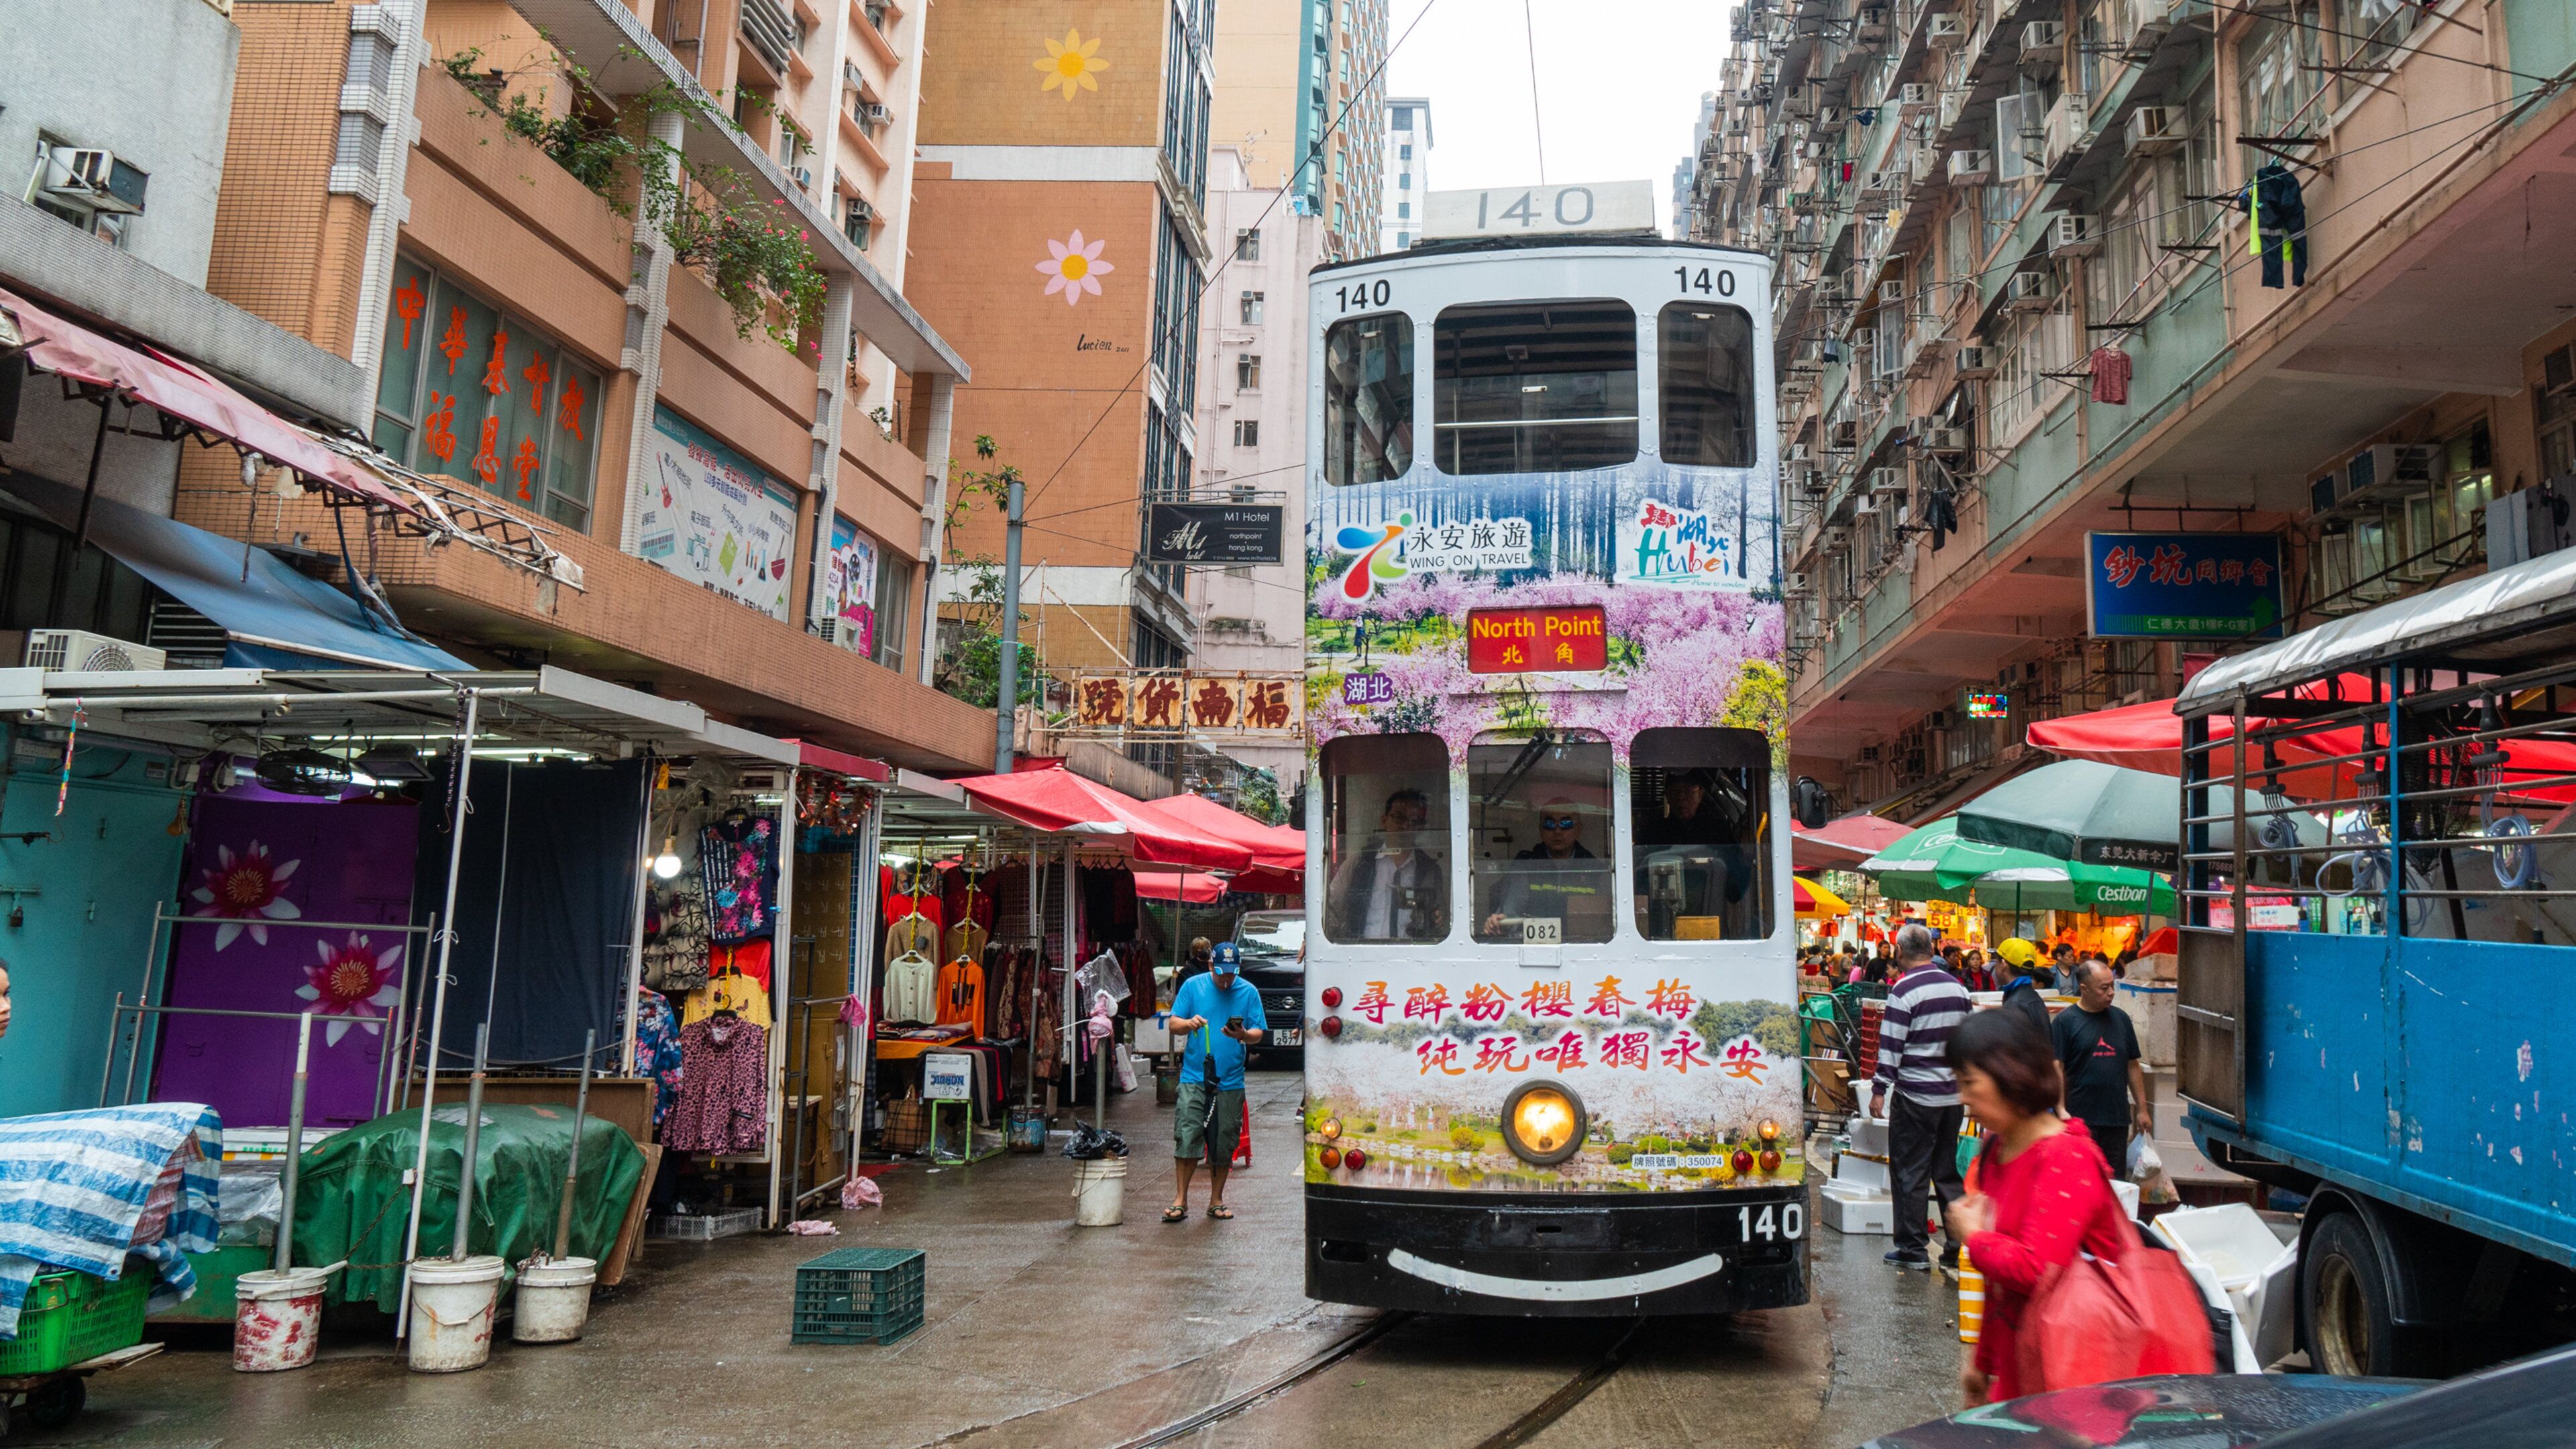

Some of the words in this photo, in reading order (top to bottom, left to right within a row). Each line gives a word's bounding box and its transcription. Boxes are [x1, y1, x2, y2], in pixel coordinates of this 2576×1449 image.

[1477, 186, 1595, 229] 140
[1674, 265, 1736, 297] 140
[1336, 279, 1391, 313] 140
[1077, 333, 1112, 352] Lucien
[396, 275, 585, 441] 中華基督教
[425, 390, 540, 502] 福恩堂
[1224, 512, 1239, 522] M1
[1242, 512, 1270, 522] Hotel
[1229, 532, 1263, 540] northpoint
[1410, 522, 1527, 553] 永安旅遊
[1676, 513, 1729, 554] 湖北
[1185, 550, 1205, 560] hotel
[1228, 544, 1246, 553] hong
[1246, 544, 1263, 553] kong
[1634, 527, 1729, 577] Hubei
[1410, 555, 1445, 569] WING
[1453, 555, 1472, 566] ON
[1481, 553, 1527, 565] TRAVEL
[2103, 543, 2275, 589] 鈔坑同鄉會
[1690, 579, 1712, 587] Home
[1472, 616, 1536, 639] North
[1545, 615, 1601, 637] Point
[2146, 617, 2249, 632] 仁德大廈1樓F-G室
[1501, 641, 1574, 665] 北角
[1346, 676, 1391, 702] 湖北
[2099, 845, 2175, 864] 东莞大新伞厂
[2097, 885, 2148, 902] C'estbon
[1931, 912, 1951, 927] 58
[1525, 924, 1557, 941] 082
[1352, 974, 1697, 1025] 尋醉粉櫻春梅
[930, 1075, 965, 1085] NORDIC
[1738, 1203, 1803, 1243] 140
